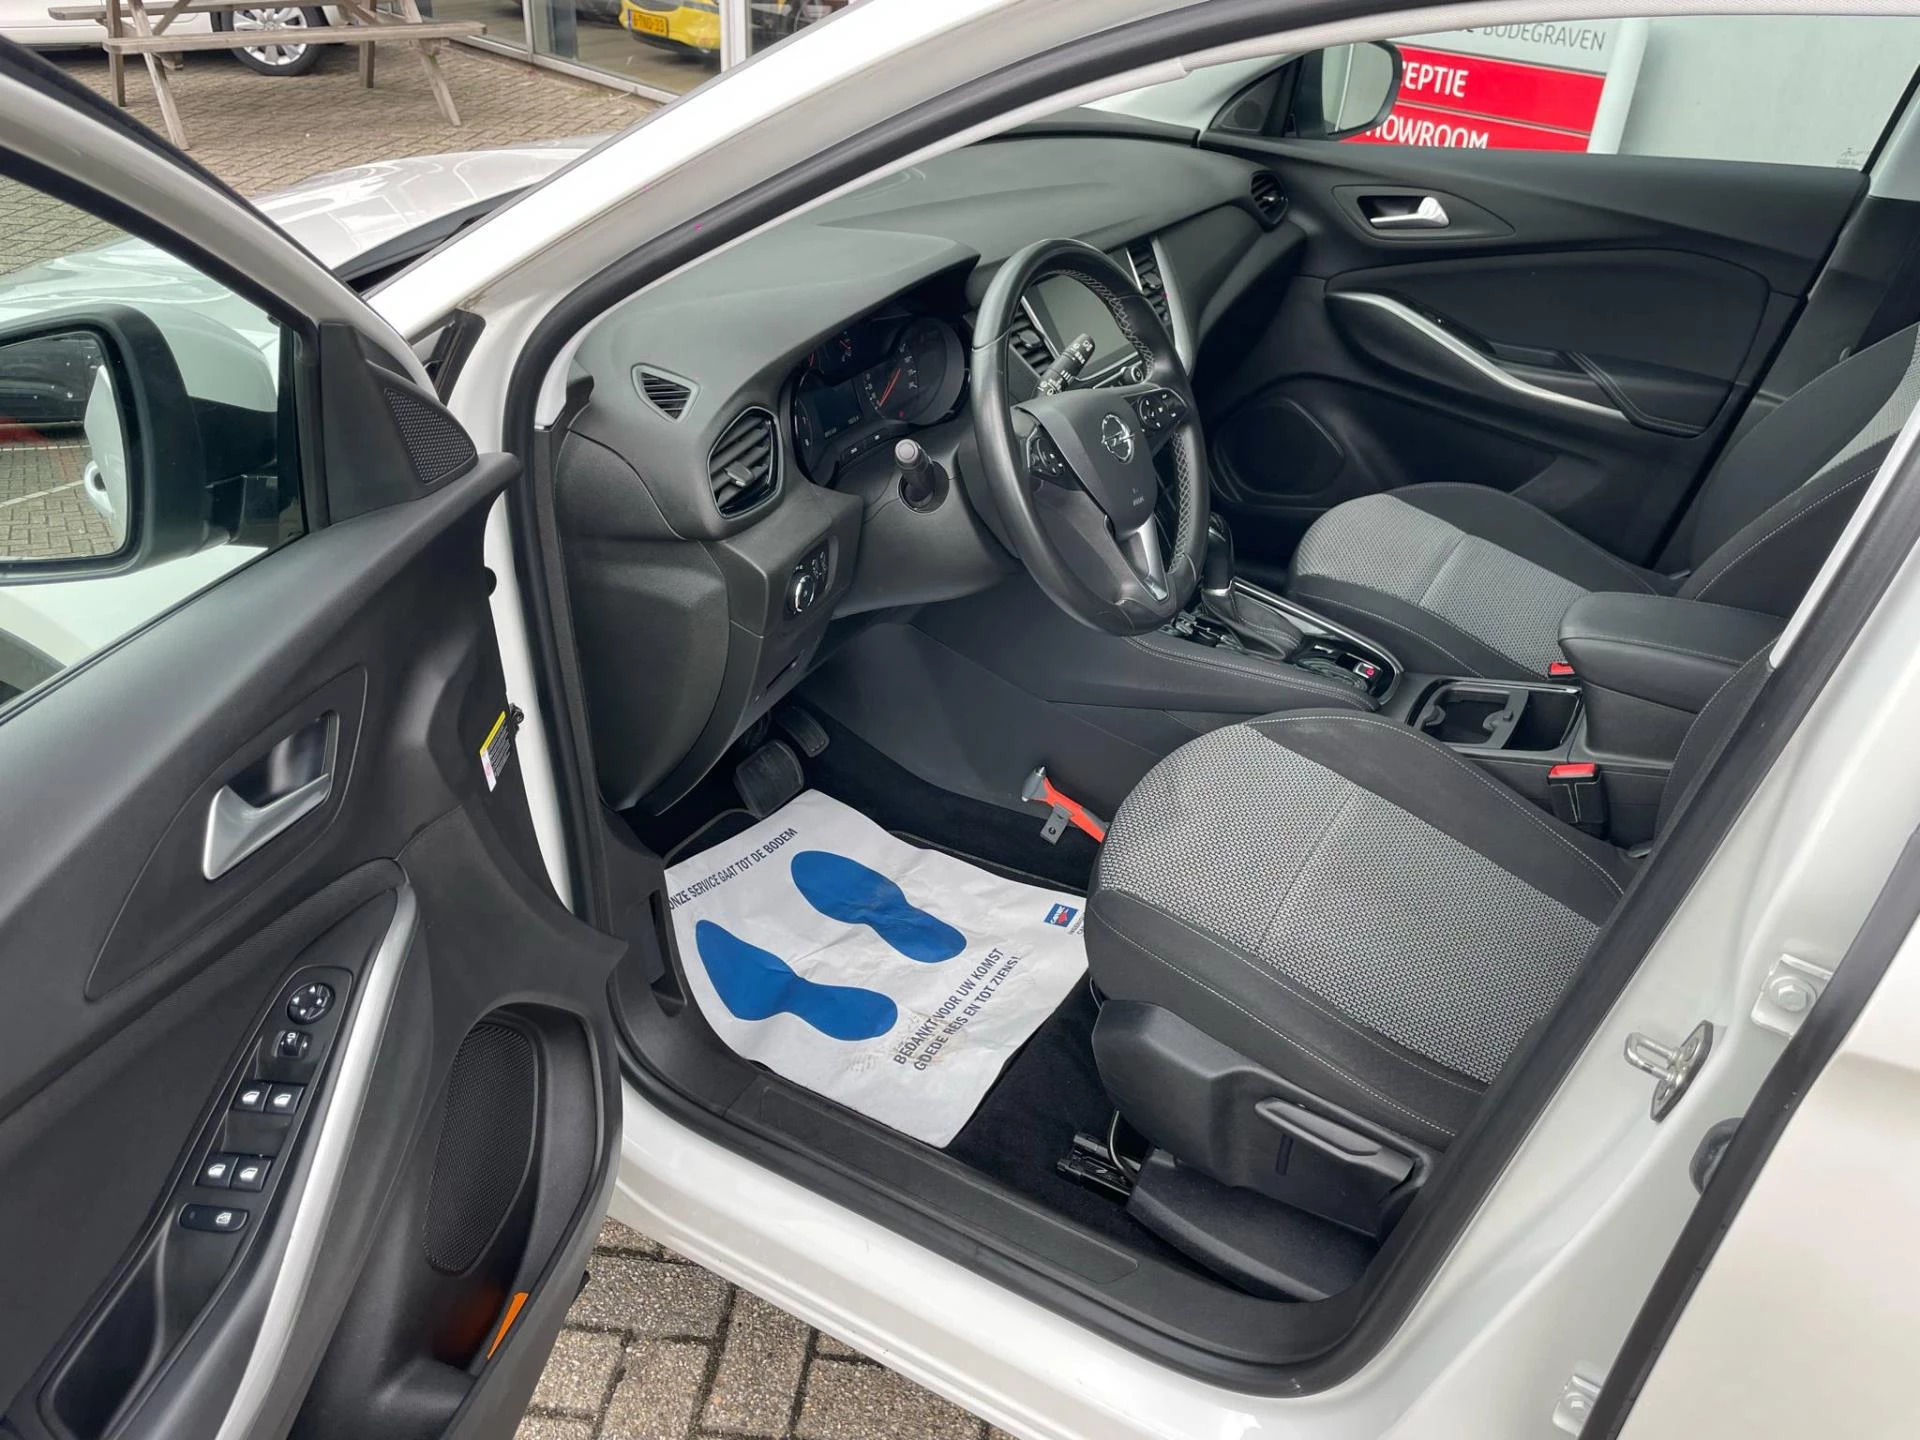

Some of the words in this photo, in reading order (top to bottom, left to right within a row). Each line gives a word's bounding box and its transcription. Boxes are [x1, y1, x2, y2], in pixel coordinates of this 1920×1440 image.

[1401, 61, 1469, 98] EPTIE
[668, 890, 691, 910] ONZE
[687, 874, 721, 897] SERVICE
[718, 864, 738, 882] GAAT
[735, 856, 753, 872] TOT
[750, 849, 767, 863] DE
[763, 828, 798, 854] BODEM
[893, 1018, 939, 1065] BEDANKT
[932, 995, 962, 1020] VOOR
[956, 979, 976, 997] UW
[971, 948, 1004, 981] KOMST
[914, 1035, 949, 1071] GOEDE
[943, 1016, 969, 1035] REIS
[963, 1003, 981, 1017] EN
[974, 985, 995, 1003] TOT
